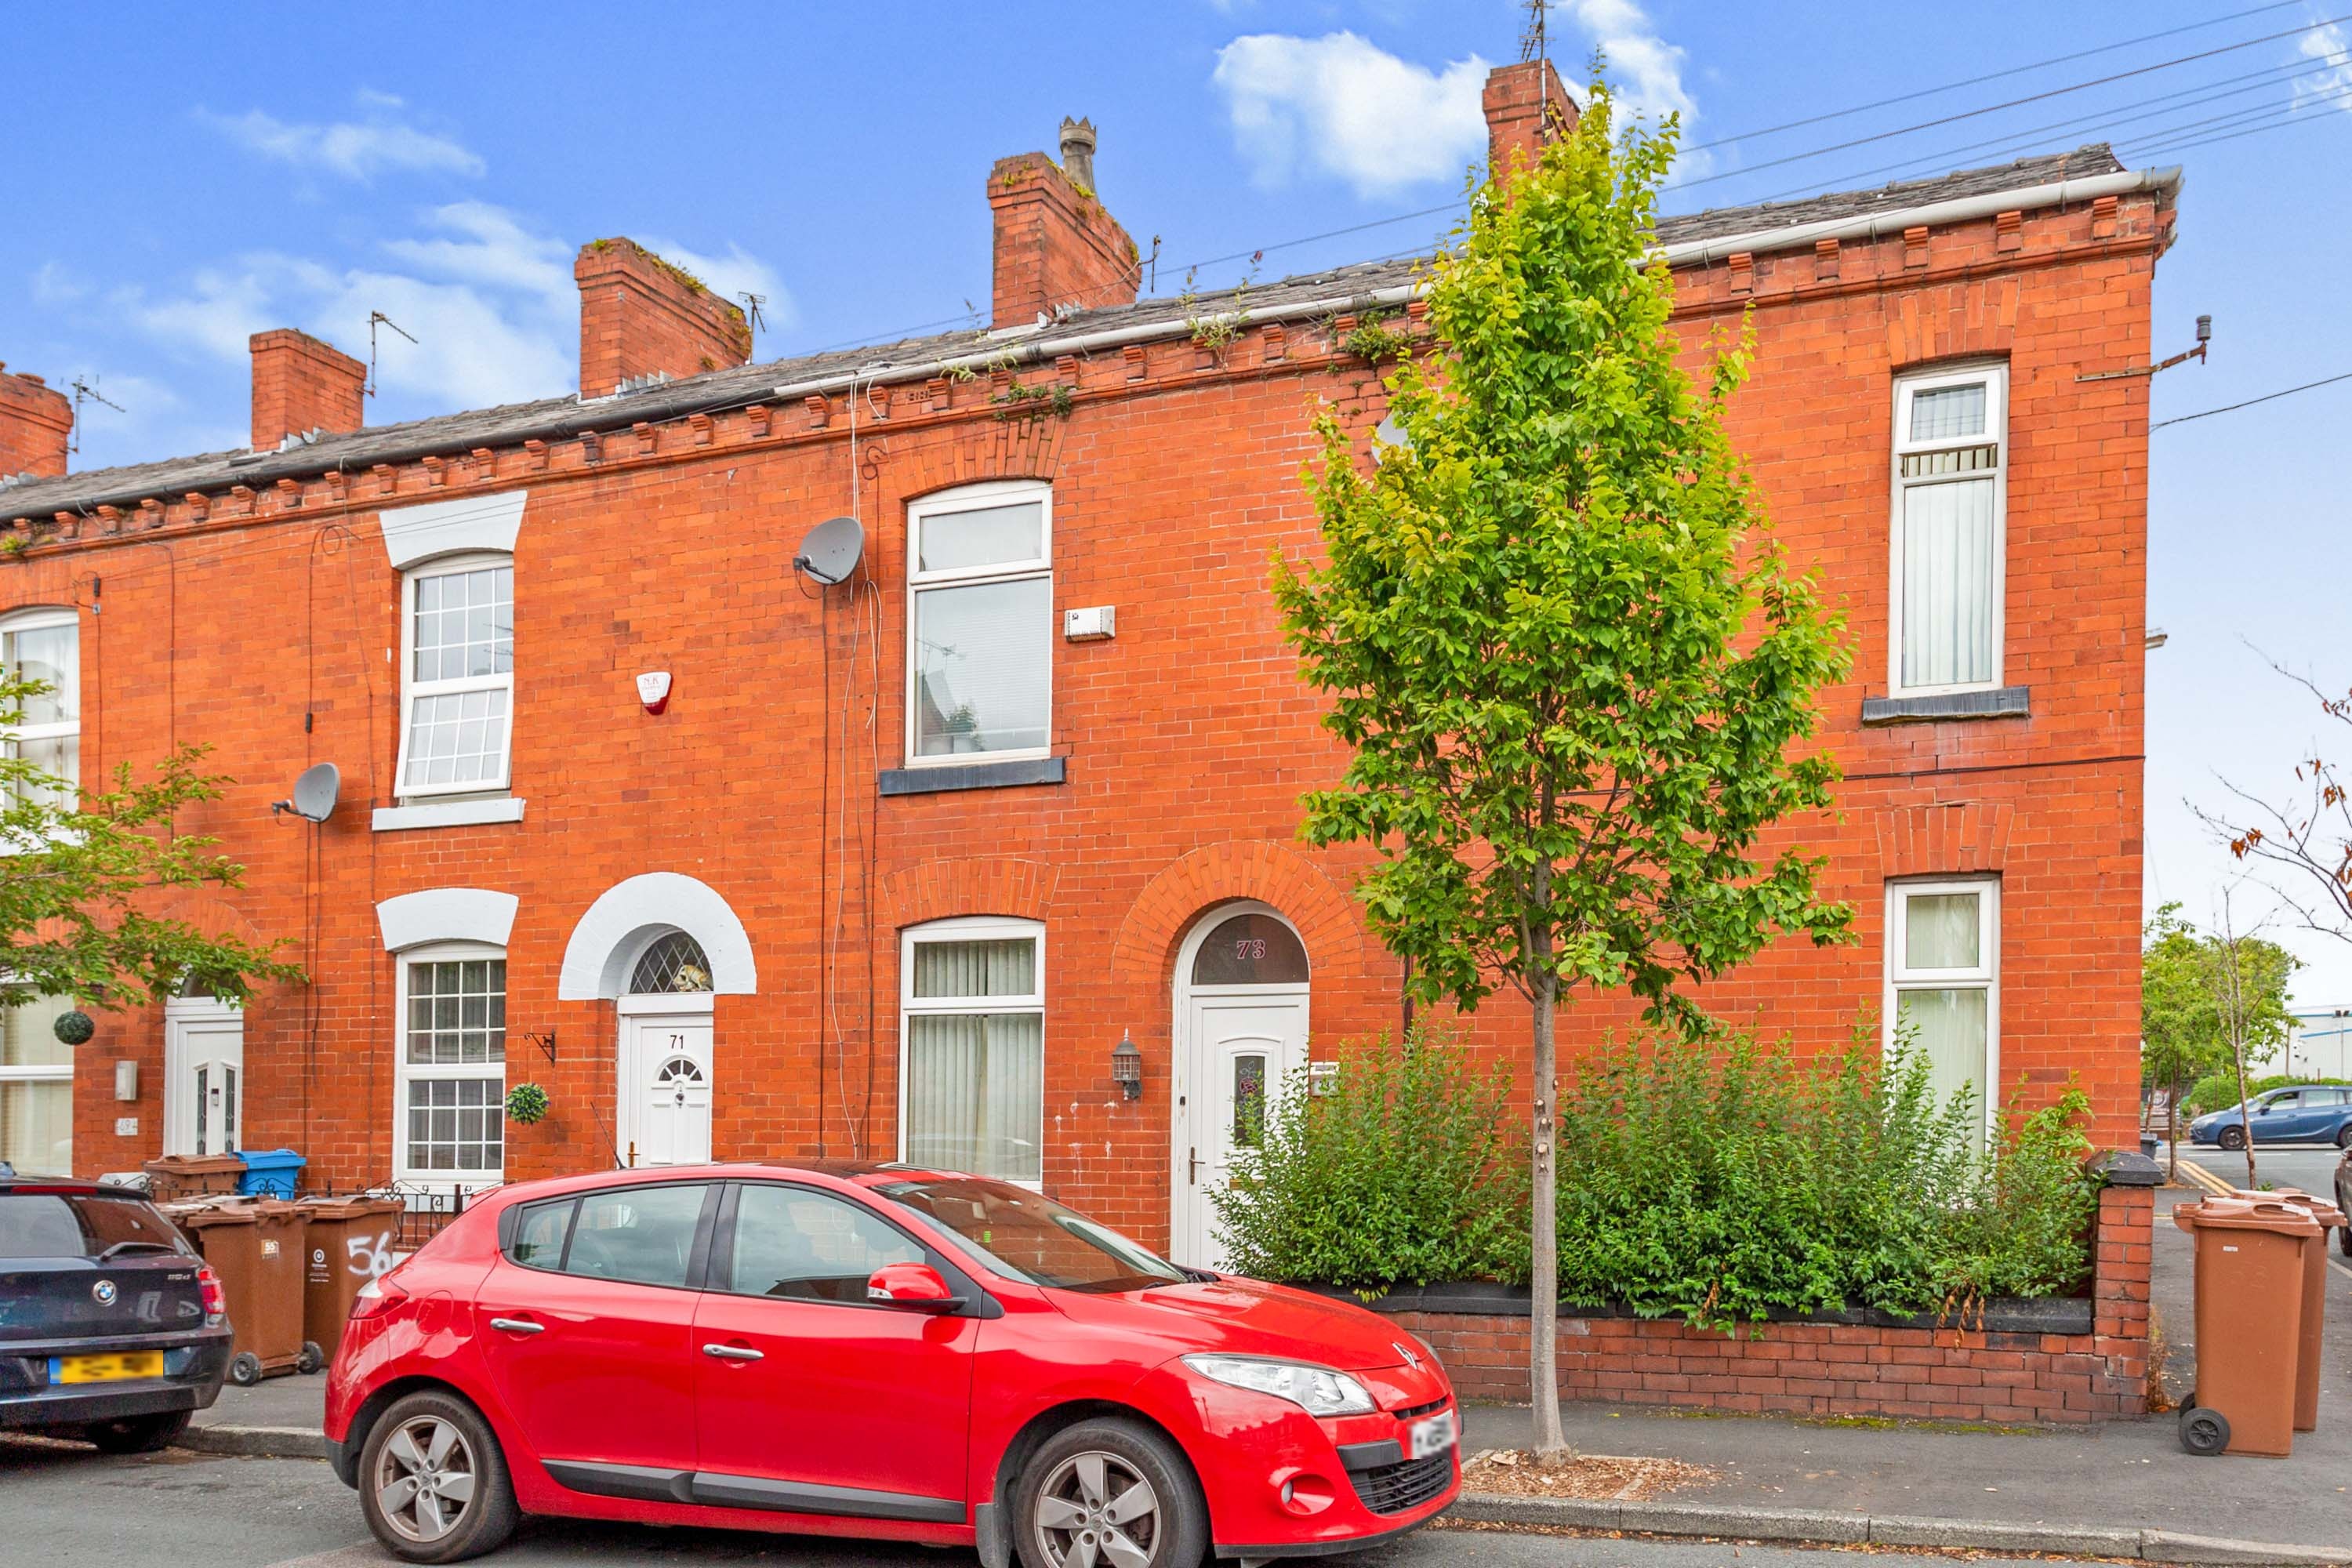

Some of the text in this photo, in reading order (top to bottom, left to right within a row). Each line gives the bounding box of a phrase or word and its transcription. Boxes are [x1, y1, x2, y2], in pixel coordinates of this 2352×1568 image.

[1236, 939, 1265, 959] 73
[670, 1034, 684, 1050] 71
[347, 1231, 391, 1278] 56
